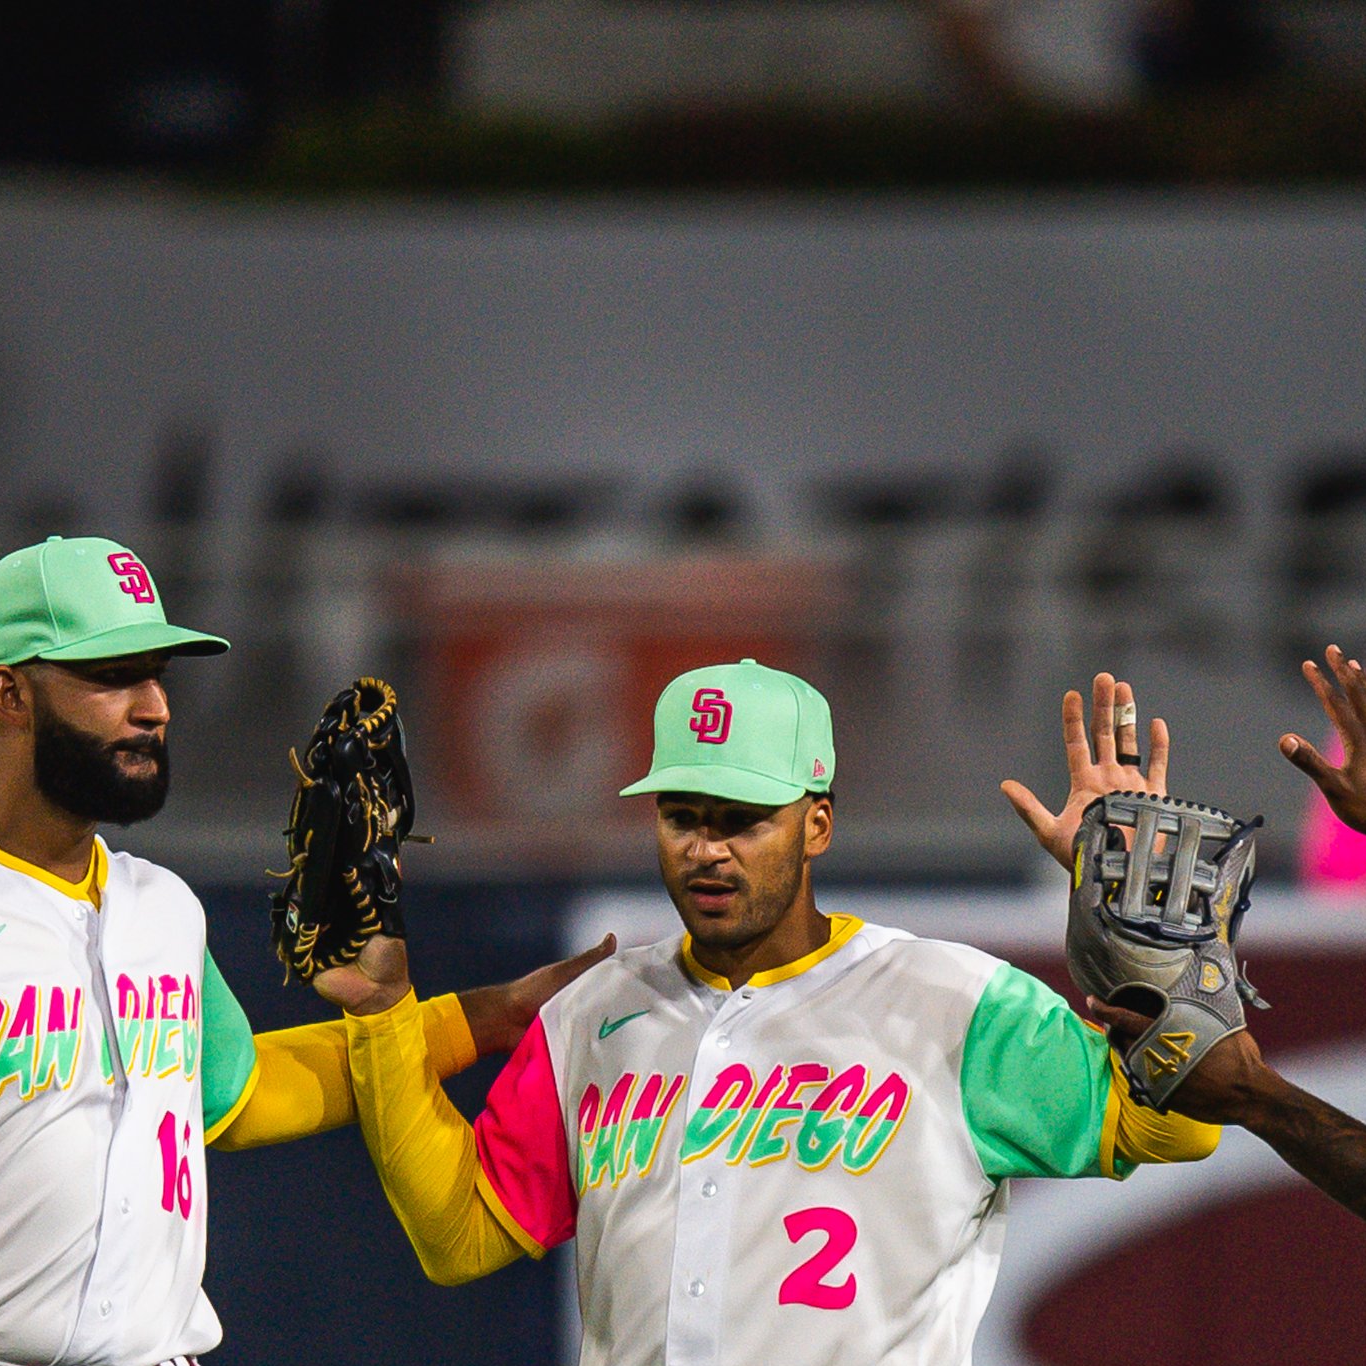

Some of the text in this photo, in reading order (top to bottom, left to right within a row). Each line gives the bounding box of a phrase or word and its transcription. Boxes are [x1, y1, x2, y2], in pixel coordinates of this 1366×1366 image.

[107, 552, 155, 604] SD
[689, 688, 733, 744] SD
[99, 972, 200, 1085] DIEG
[156, 1110, 193, 1221] 16
[679, 1063, 912, 1177] DIEGO
[778, 1206, 858, 1311] 2
